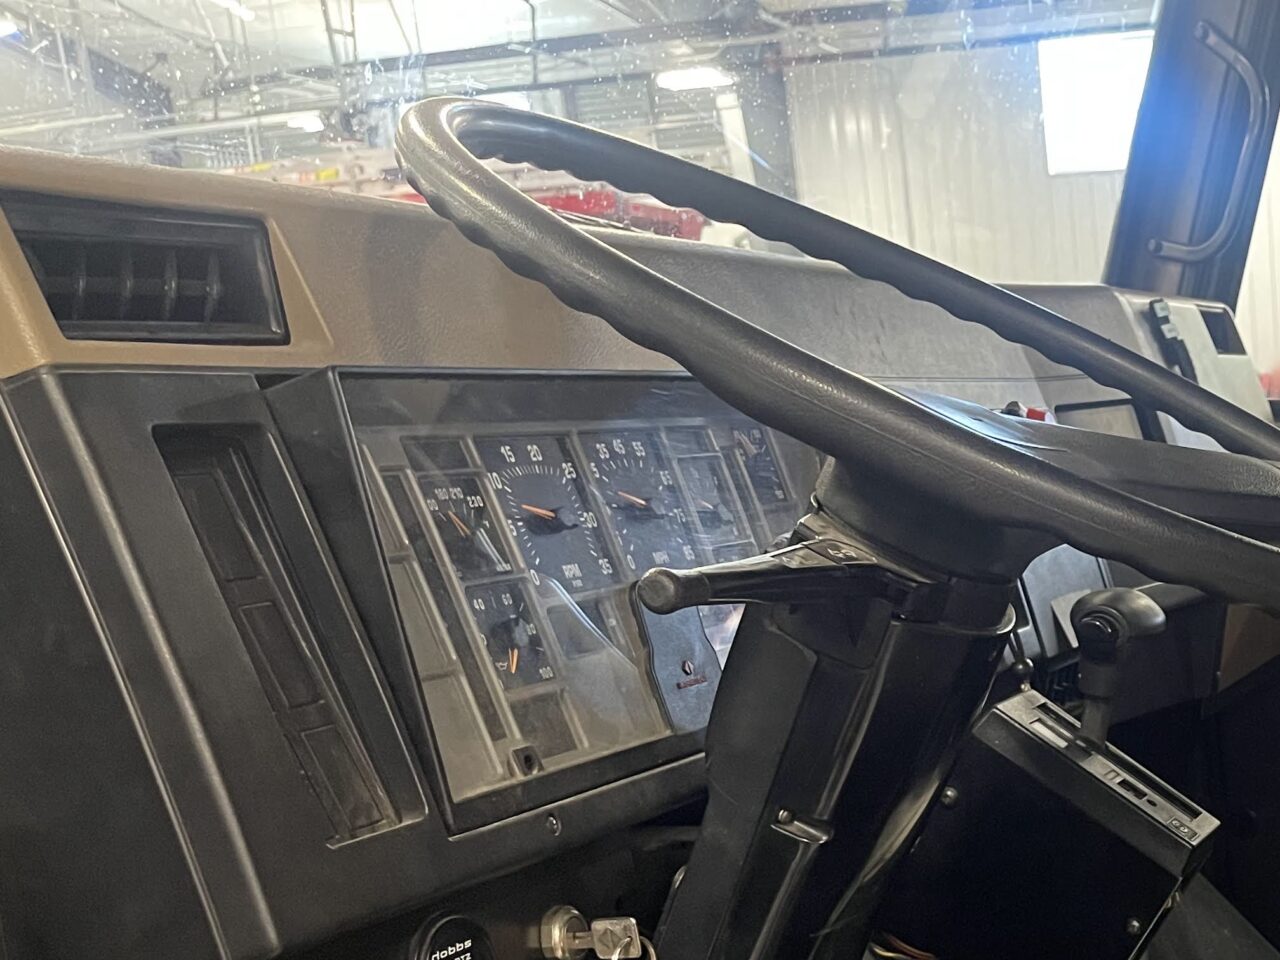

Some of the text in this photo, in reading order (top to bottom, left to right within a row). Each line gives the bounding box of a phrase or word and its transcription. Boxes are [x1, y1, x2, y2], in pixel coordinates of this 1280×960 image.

[501, 445, 516, 462] 15
[527, 444, 543, 461] 20
[596, 443, 610, 459] 35
[612, 439, 626, 455] 45
[632, 441, 646, 457] 55
[562, 462, 577, 479] 25
[487, 472, 503, 489] 10
[507, 519, 518, 537] 5
[583, 511, 598, 528] 30
[627, 554, 636, 570] 0
[652, 550, 670, 564] MPH
[562, 563, 583, 578] RPM
[599, 558, 613, 575] 35
[529, 569, 540, 586] 0
[473, 598, 485, 611] 40
